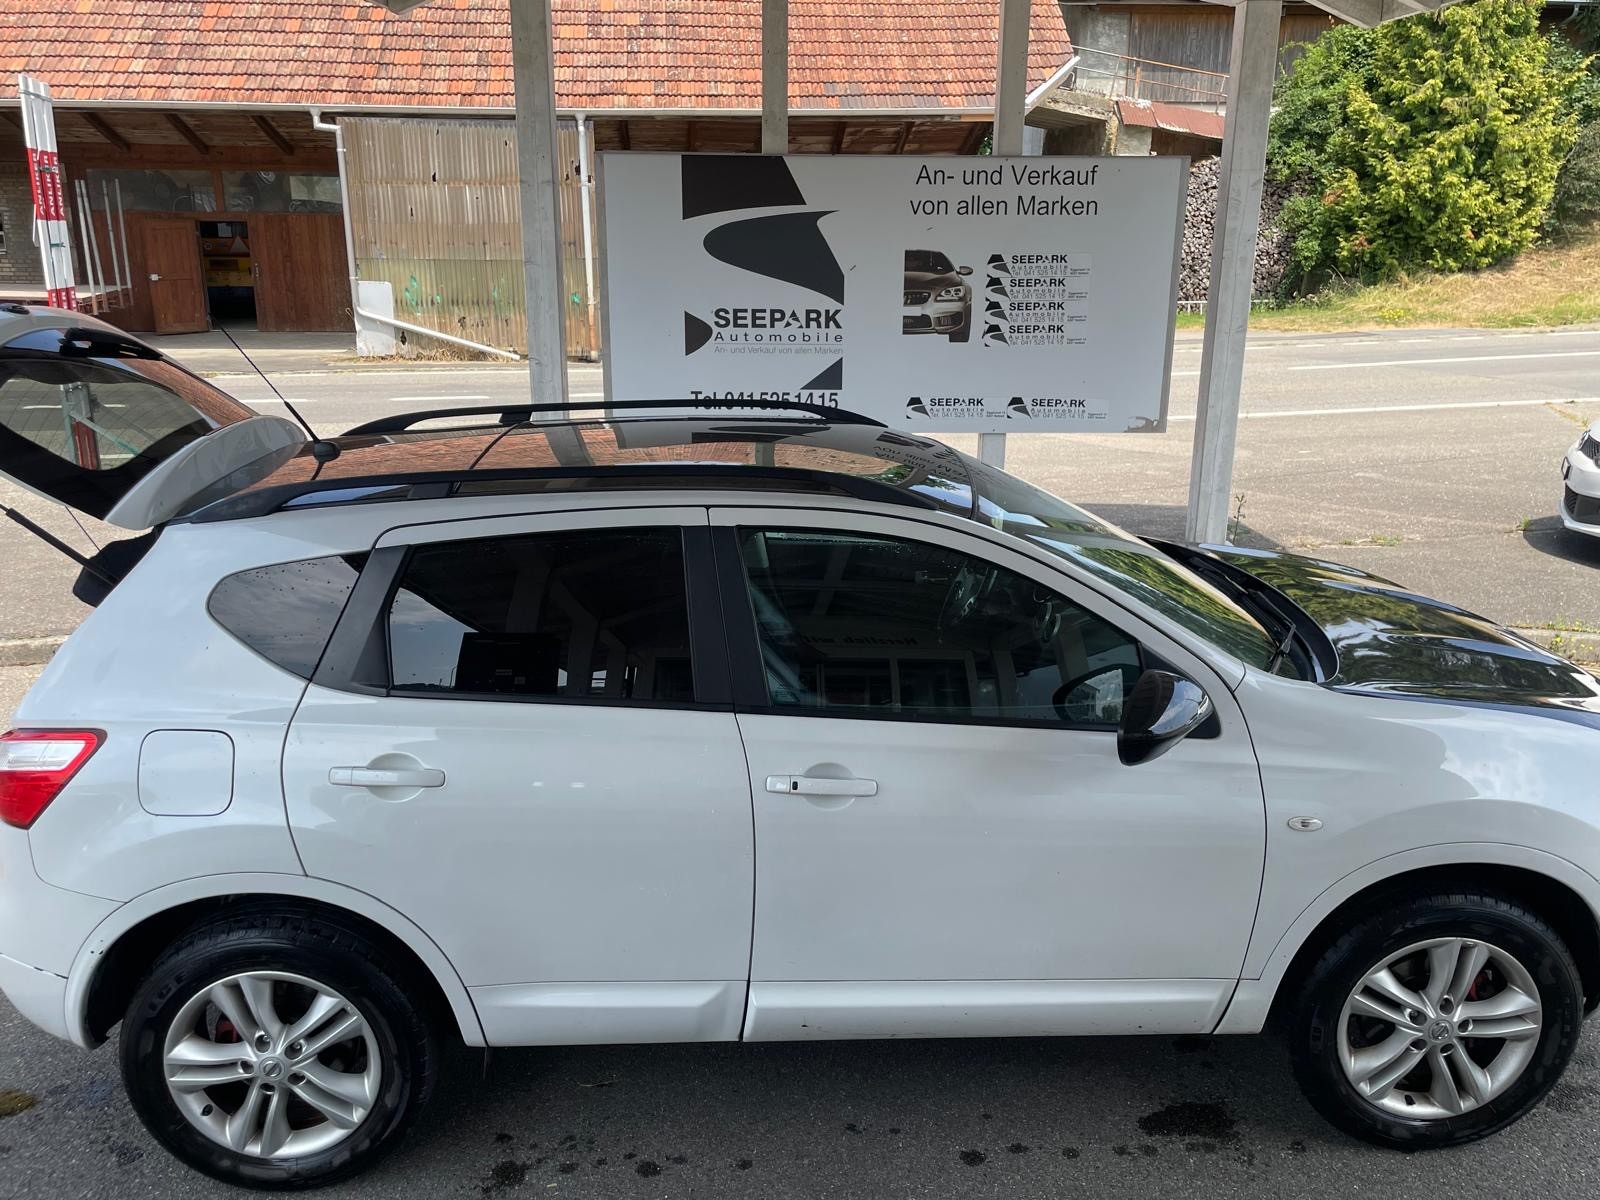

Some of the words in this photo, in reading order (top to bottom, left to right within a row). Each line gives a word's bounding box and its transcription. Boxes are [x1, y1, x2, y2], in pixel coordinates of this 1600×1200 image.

[916, 165, 954, 185] An-
[963, 165, 1002, 186] und
[1011, 165, 1099, 186] Verkauf
[43, 155, 56, 216] ANLIKR
[910, 200, 948, 215] von
[957, 195, 1008, 215] allen
[1017, 195, 1098, 215] Marken
[1011, 254, 1068, 264] SEEPARK
[1010, 278, 1066, 287] SEEPARK
[1009, 302, 1065, 311] SEEPARK
[714, 308, 842, 329] SEEPARK
[1009, 324, 1064, 333] SEEPARK
[714, 332, 843, 342] Automobile
[730, 346, 746, 354] und
[748, 346, 777, 354] Verkauf
[815, 347, 843, 355] Marken
[929, 398, 984, 406] SEEPARK
[1031, 398, 1086, 407] SEEPARK
